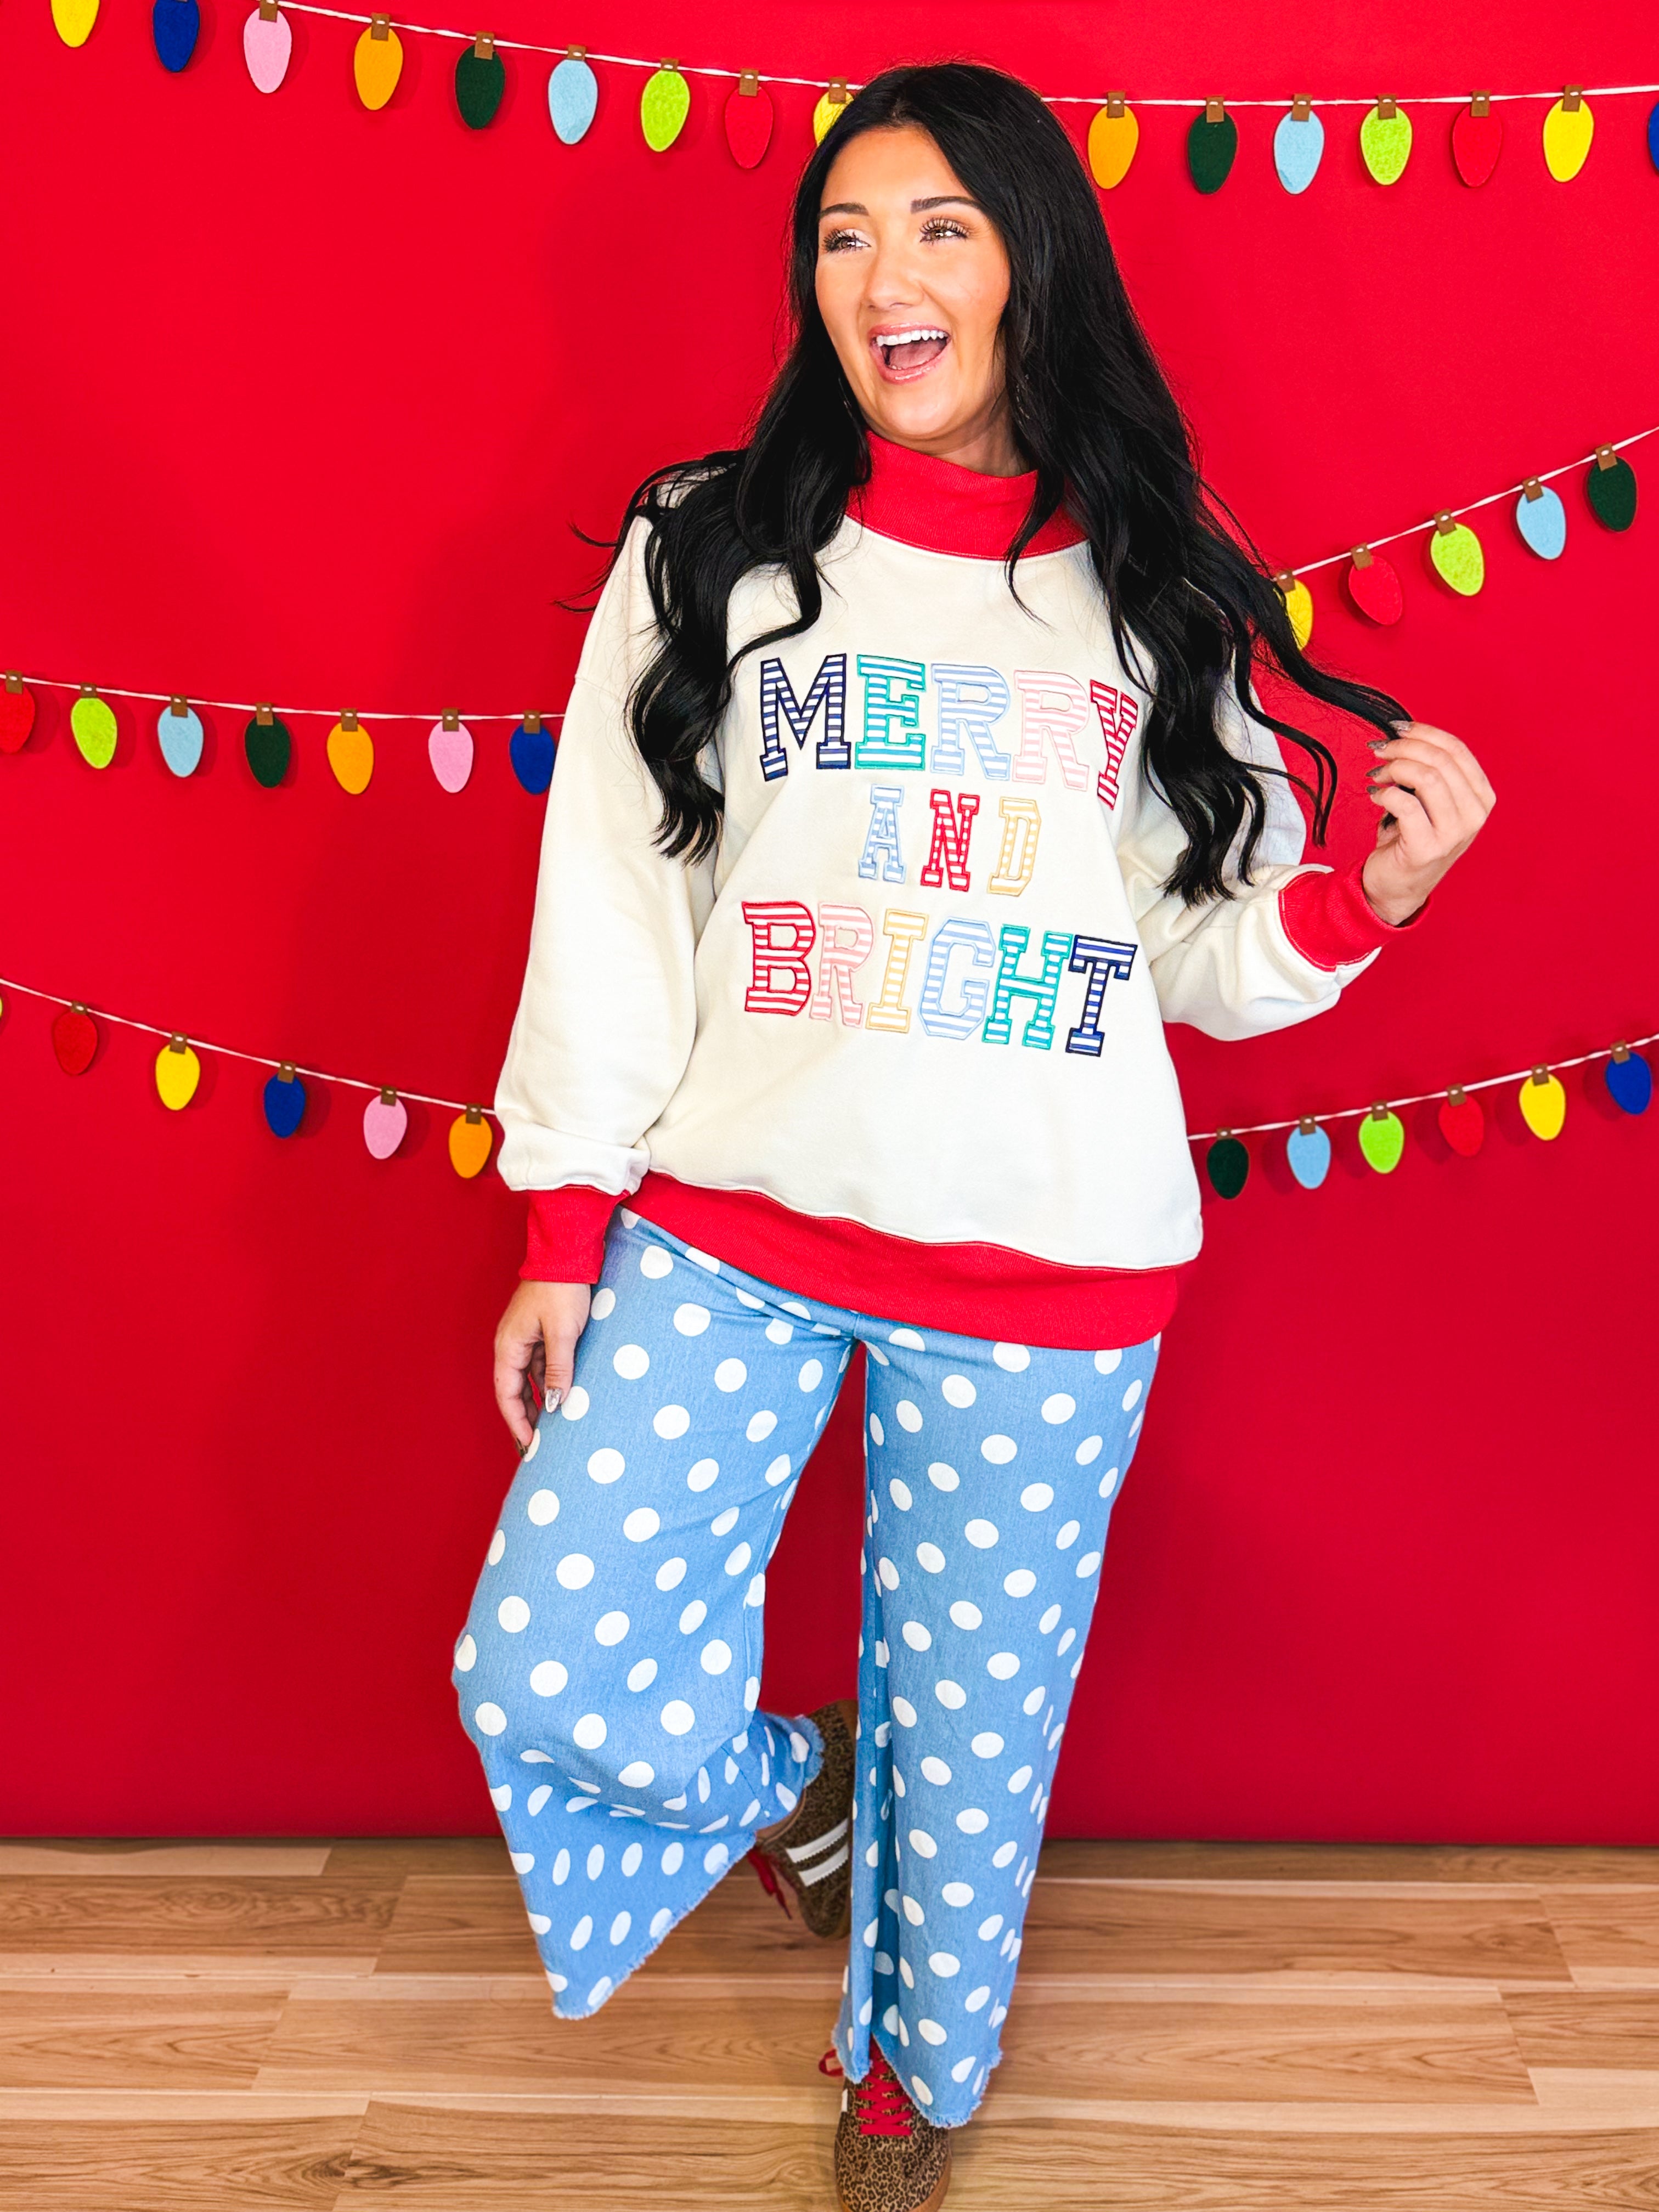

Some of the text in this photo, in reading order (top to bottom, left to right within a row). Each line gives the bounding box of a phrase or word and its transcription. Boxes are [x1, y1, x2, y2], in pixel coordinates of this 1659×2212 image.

[760, 653, 1138, 810] MERRY
[858, 783, 1041, 897] AND
[741, 900, 1138, 1057] BRIGHT
